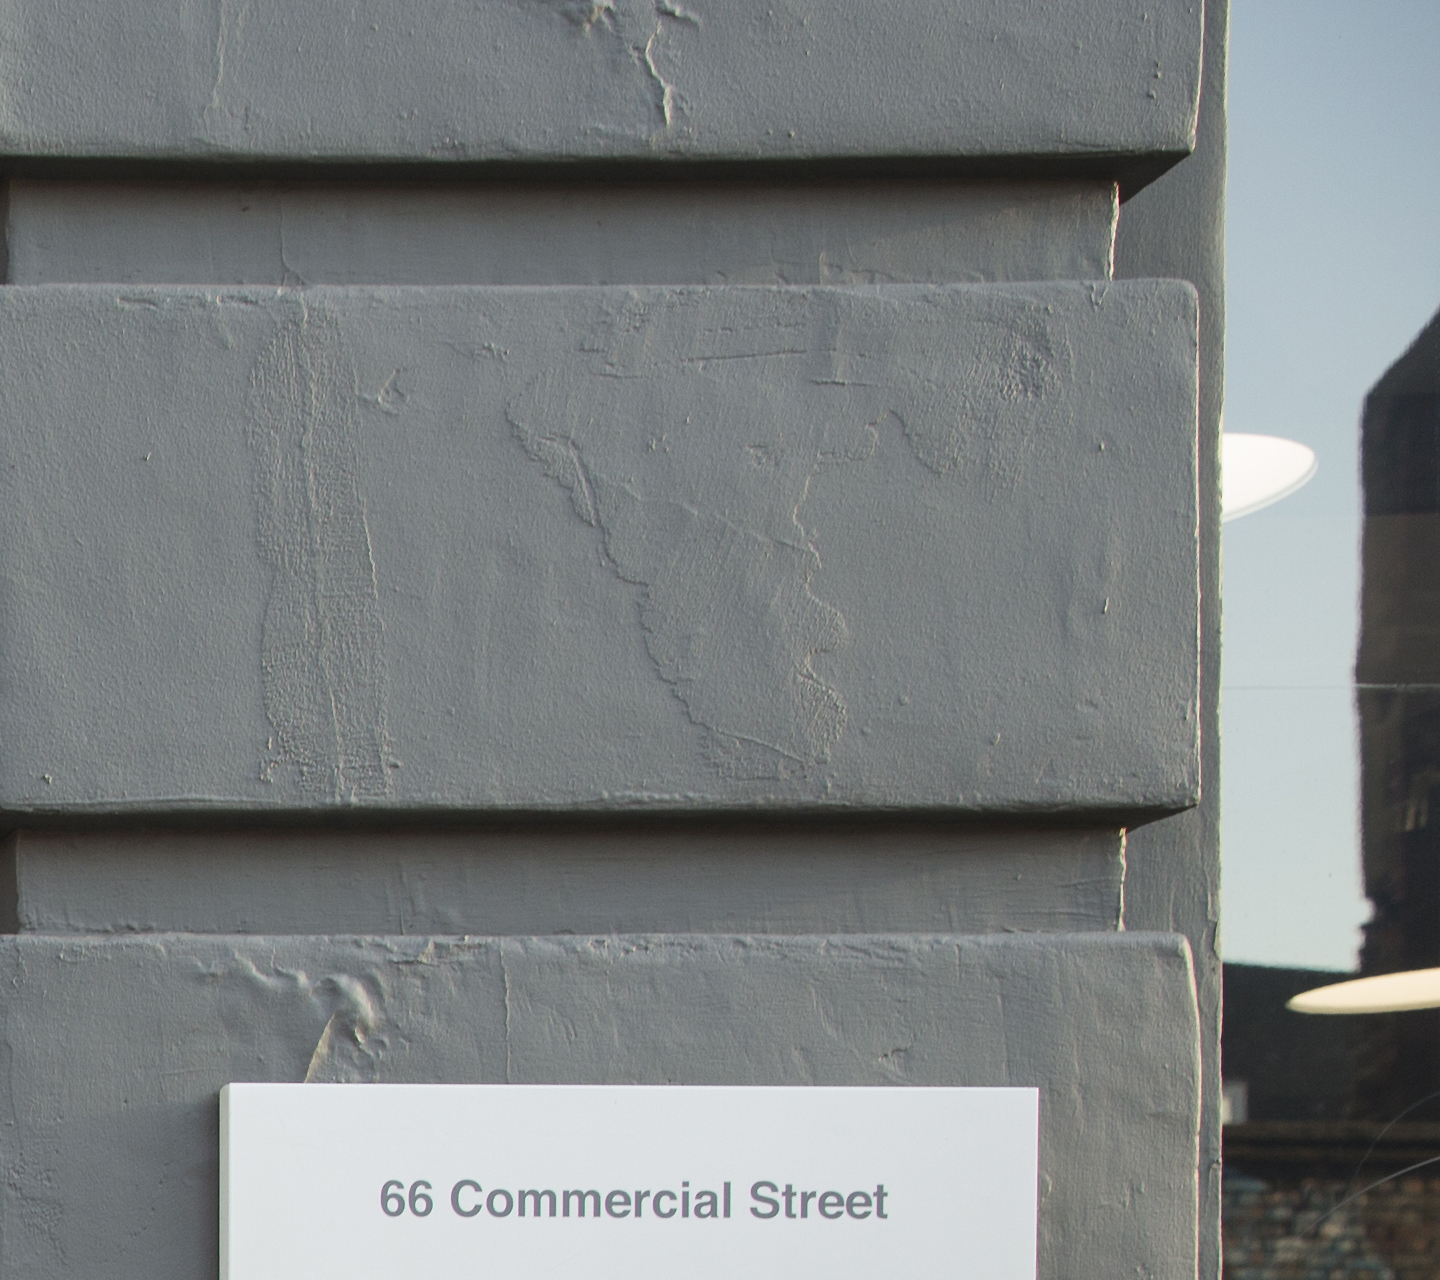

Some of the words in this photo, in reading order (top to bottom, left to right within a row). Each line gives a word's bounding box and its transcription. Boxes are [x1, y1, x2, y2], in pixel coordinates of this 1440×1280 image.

[381, 1180, 433, 1218] 66
[451, 1180, 731, 1218] Commercial
[750, 1181, 888, 1219] Street
